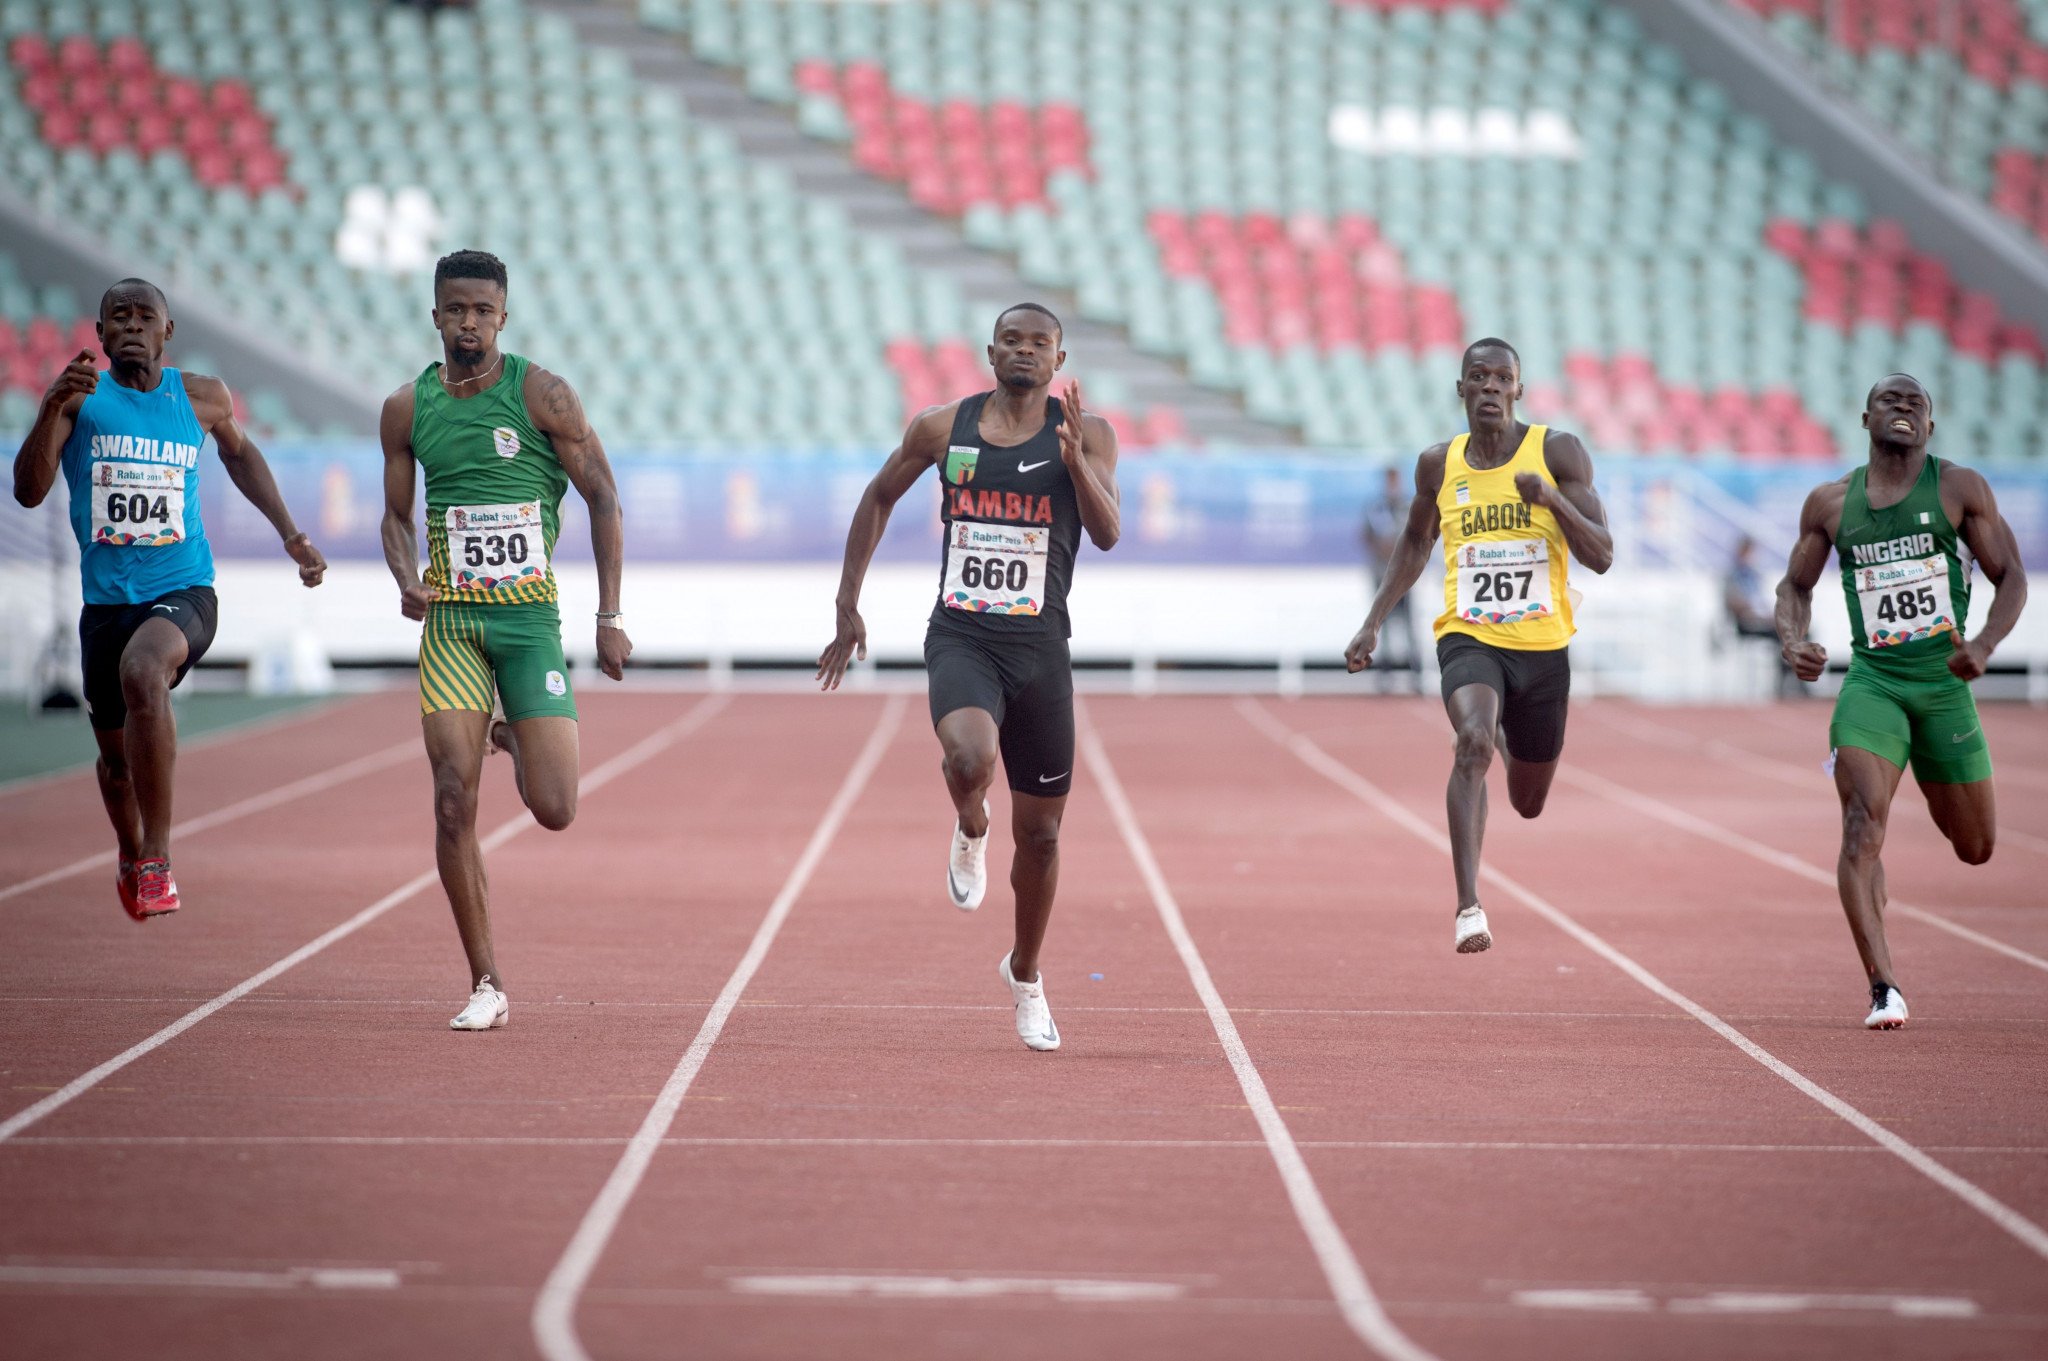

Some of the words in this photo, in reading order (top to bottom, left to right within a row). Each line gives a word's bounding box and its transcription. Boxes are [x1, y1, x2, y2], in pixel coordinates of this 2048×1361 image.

[91, 434, 198, 468] SWAZILAND
[117, 469, 144, 480] Rabat
[107, 493, 169, 524] 604
[470, 512, 499, 522] Rabat
[1461, 502, 1531, 537] GABON
[464, 533, 528, 567] 530
[972, 531, 1002, 543] Rabat
[1005, 537, 1021, 545] 2019
[1479, 549, 1506, 559] Rabat
[1852, 532, 1934, 565] NIGERIA
[961, 555, 1028, 592] 660
[1472, 570, 1533, 602] 267
[1878, 568, 1905, 581] Rabat
[1907, 568, 1923, 576] 2019
[1877, 585, 1937, 623] 485
